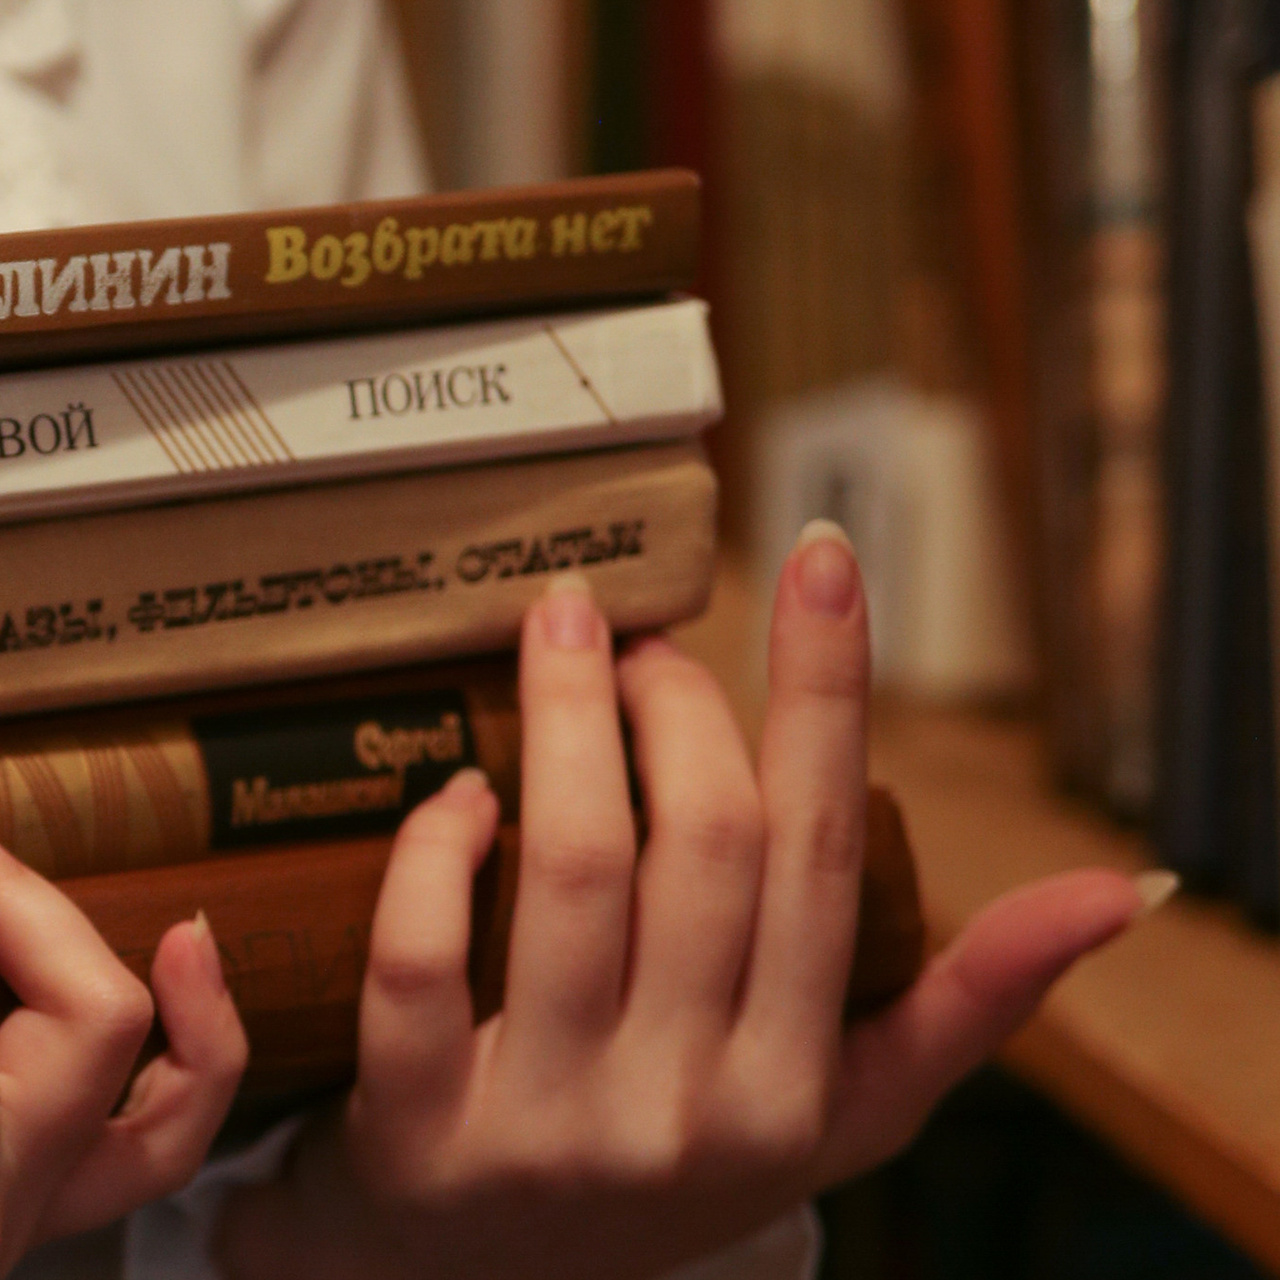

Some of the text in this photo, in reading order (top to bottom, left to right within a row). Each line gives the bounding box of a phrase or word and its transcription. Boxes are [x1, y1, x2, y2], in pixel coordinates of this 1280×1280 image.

[264, 215, 537, 287] Возврата
[550, 204, 653, 258] нет
[346, 363, 511, 421] ПОИСК
[456, 521, 645, 583] СТАТЬИ
